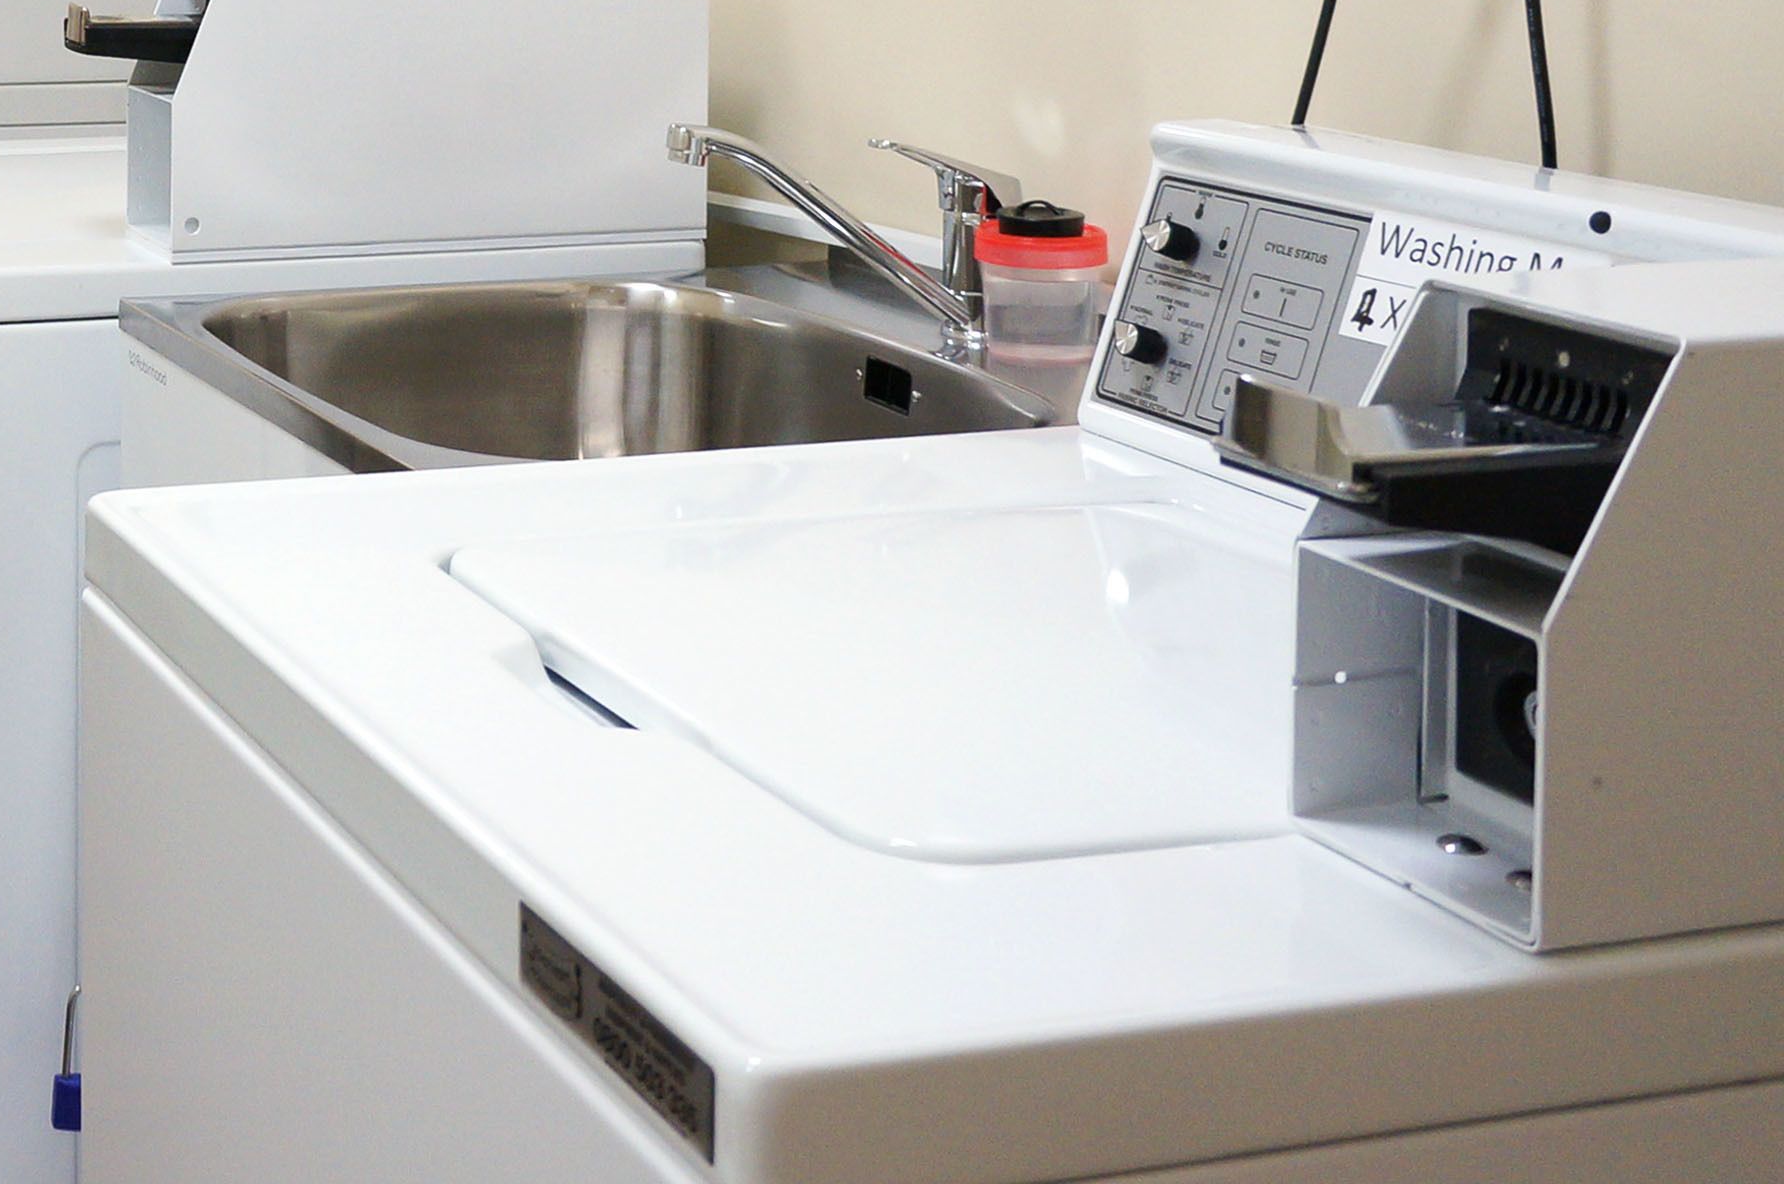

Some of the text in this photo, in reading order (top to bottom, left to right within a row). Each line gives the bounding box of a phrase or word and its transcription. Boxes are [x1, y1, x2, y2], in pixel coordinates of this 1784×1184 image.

[1264, 241, 1328, 265] CYCLE STATUS
[1380, 222, 1518, 274] Washing
